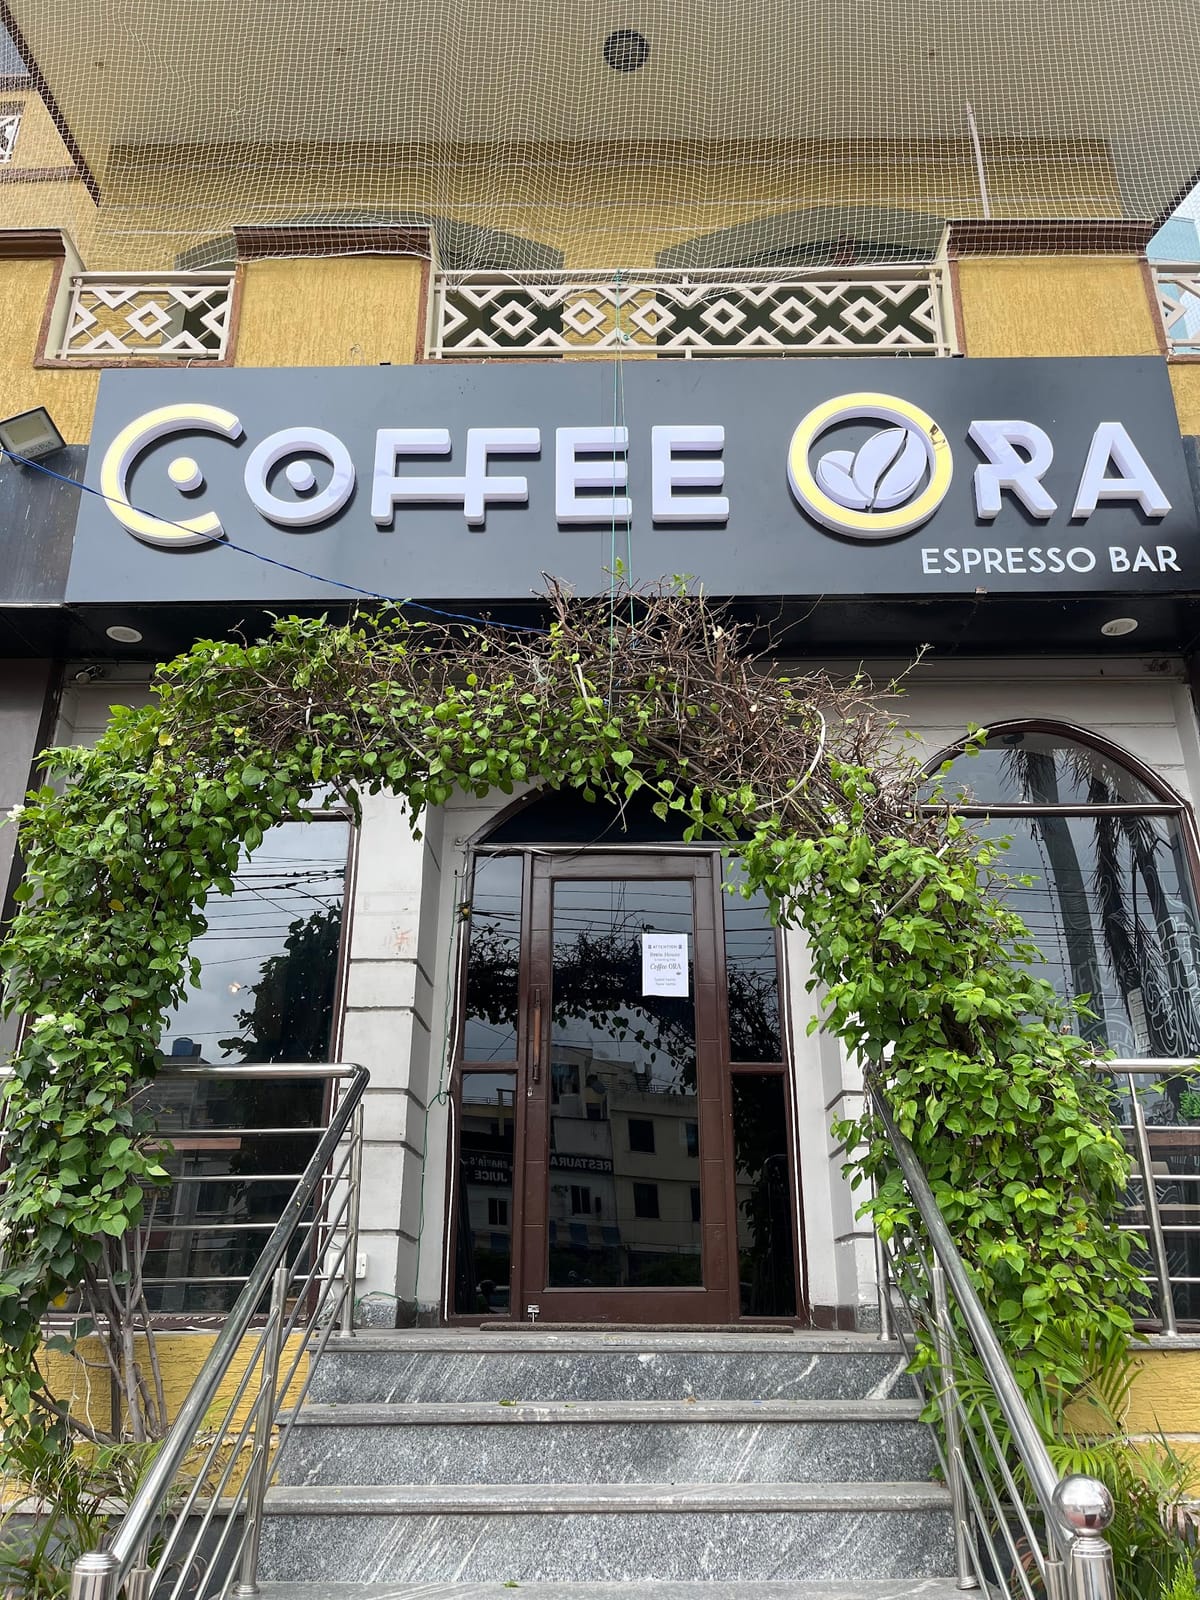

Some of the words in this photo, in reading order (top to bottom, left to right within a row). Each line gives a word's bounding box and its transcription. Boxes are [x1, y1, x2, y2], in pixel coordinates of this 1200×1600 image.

[100, 403, 730, 547] COFFEE
[787, 392, 1173, 539] ORA
[921, 547, 1096, 574] ESPRESSO
[1108, 545, 1182, 572] BAR
[650, 963, 667, 971] Coffee
